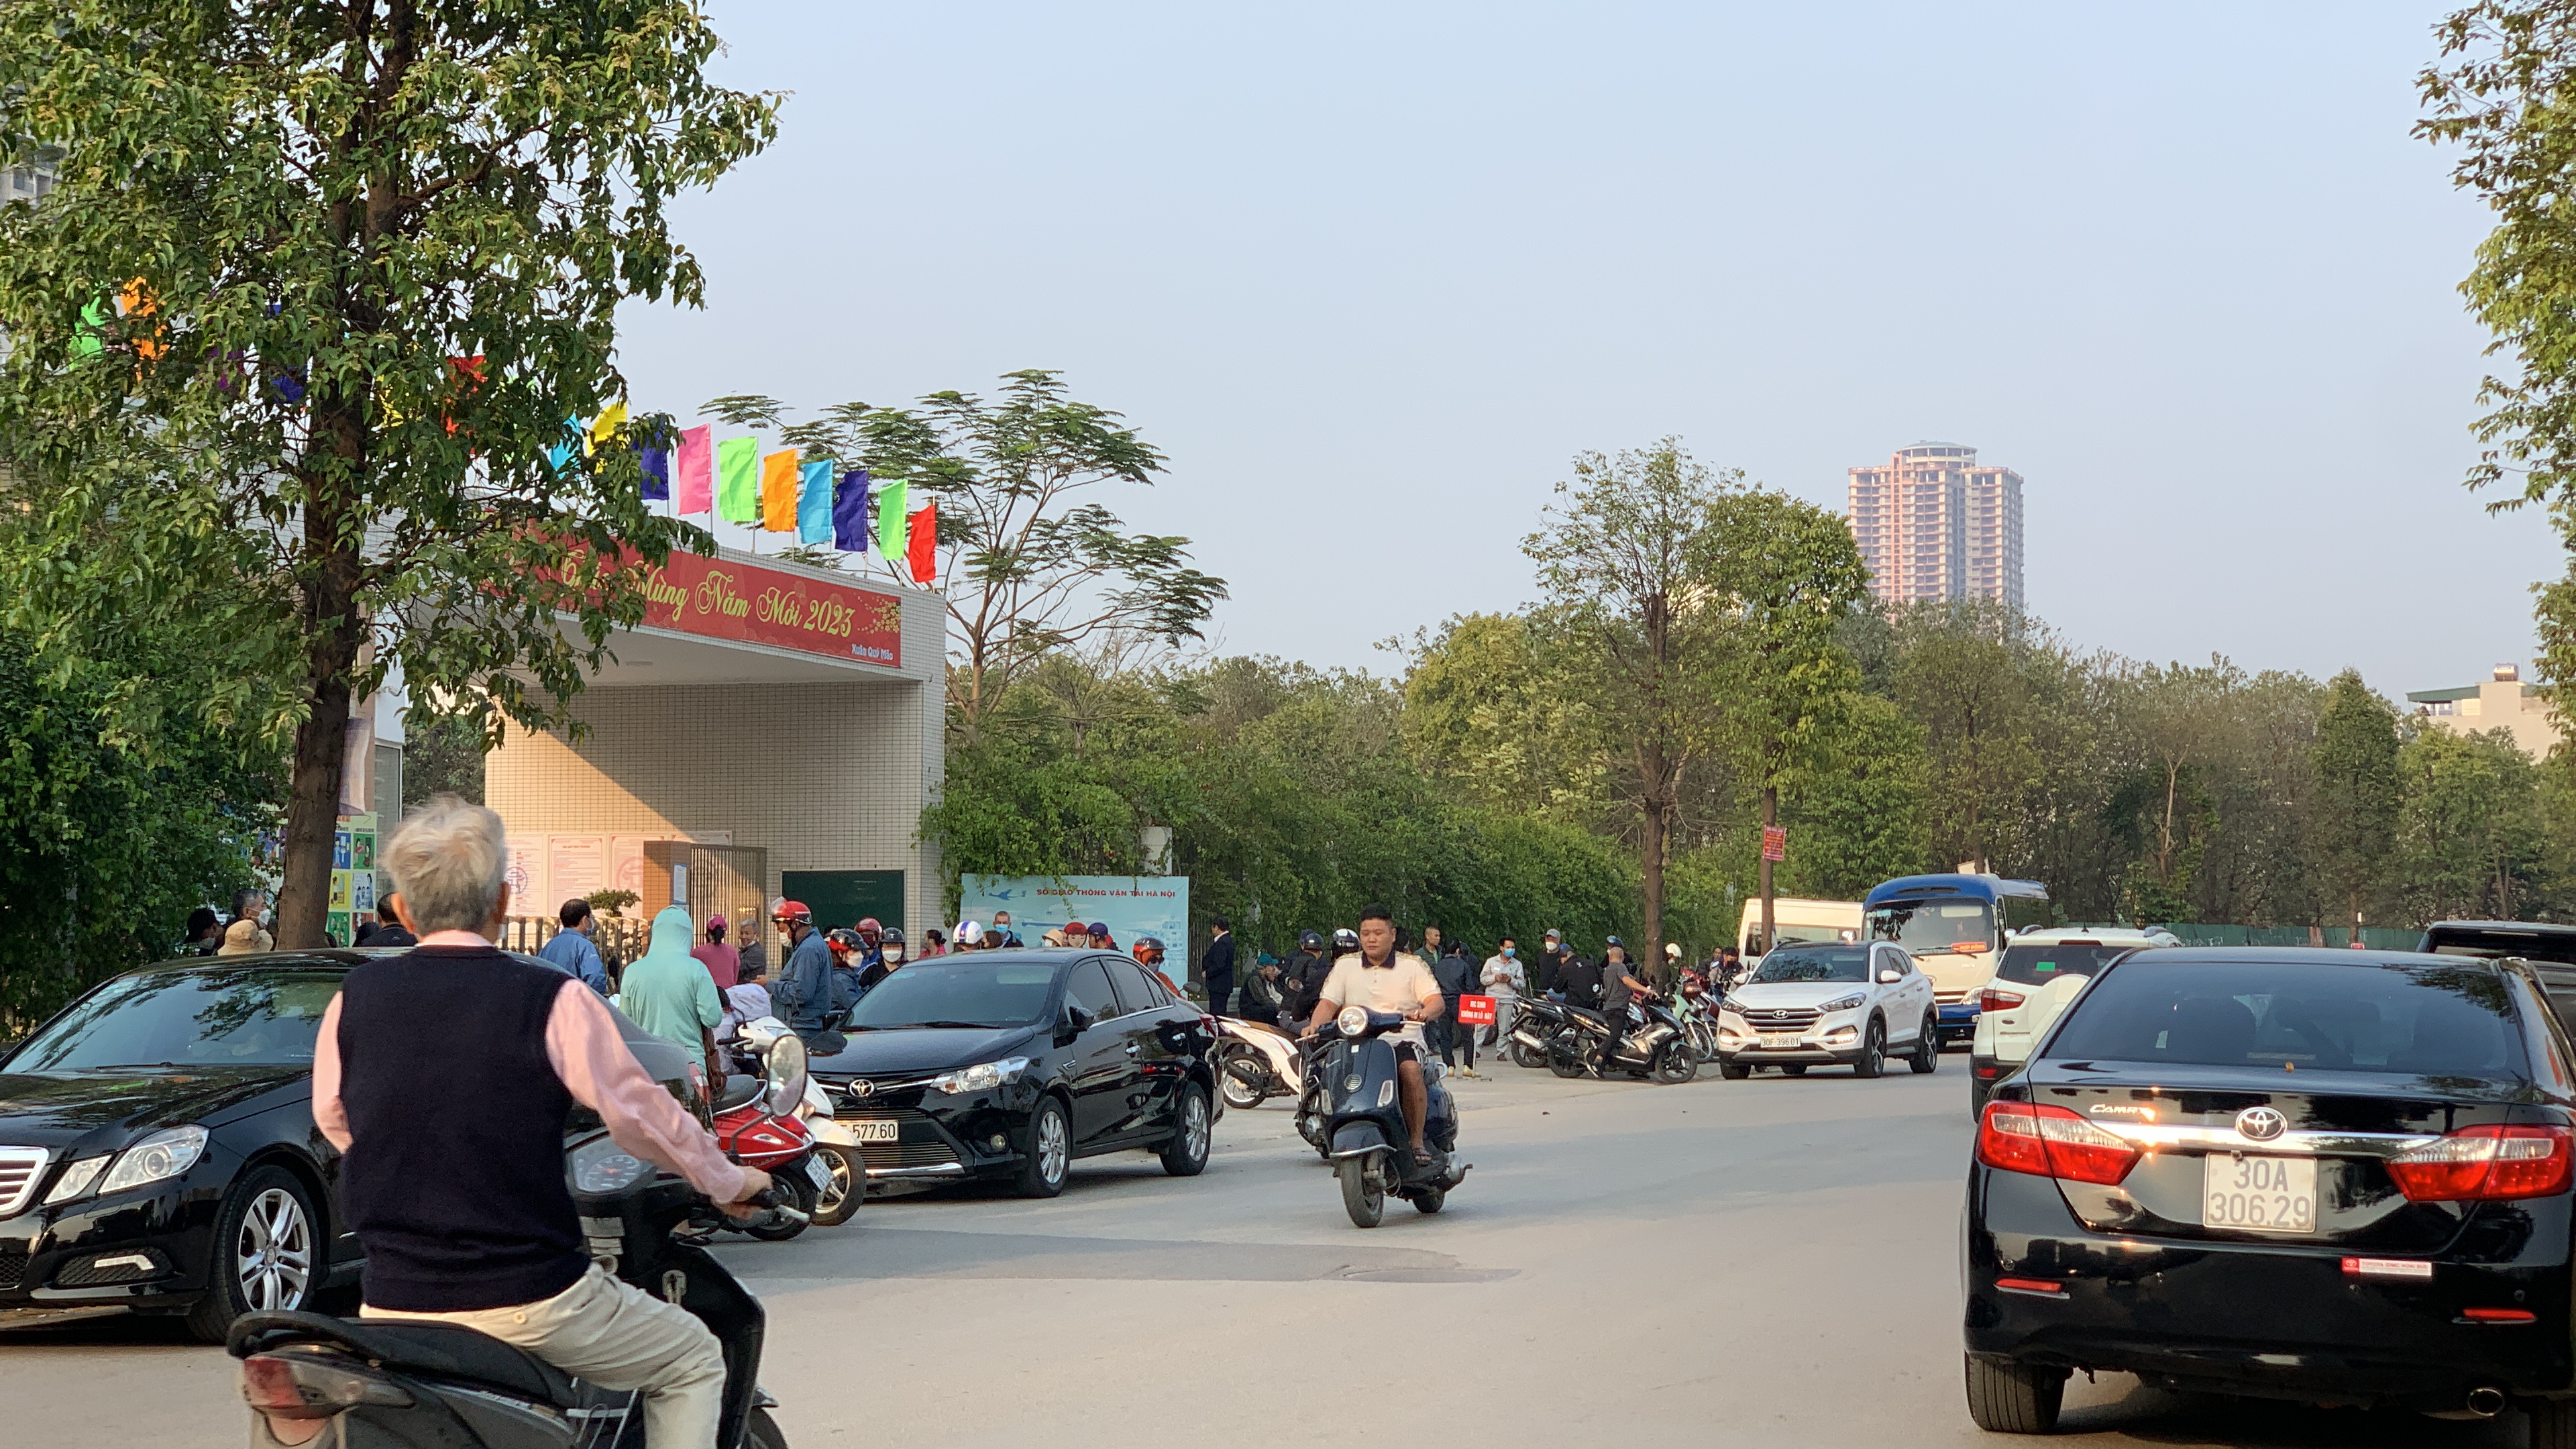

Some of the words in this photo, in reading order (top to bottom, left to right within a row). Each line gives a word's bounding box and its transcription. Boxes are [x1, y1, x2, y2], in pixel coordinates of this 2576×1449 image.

[695, 570, 751, 618] Năm
[756, 586, 802, 627] Mới
[803, 600, 855, 637] 2023
[1076, 888, 1106, 896] THÔNG
[1109, 889, 1127, 898] VẬN
[1161, 890, 1175, 898] NỘI
[2234, 1159, 2288, 1192] 30A
[2210, 1192, 2311, 1227] 306.29
